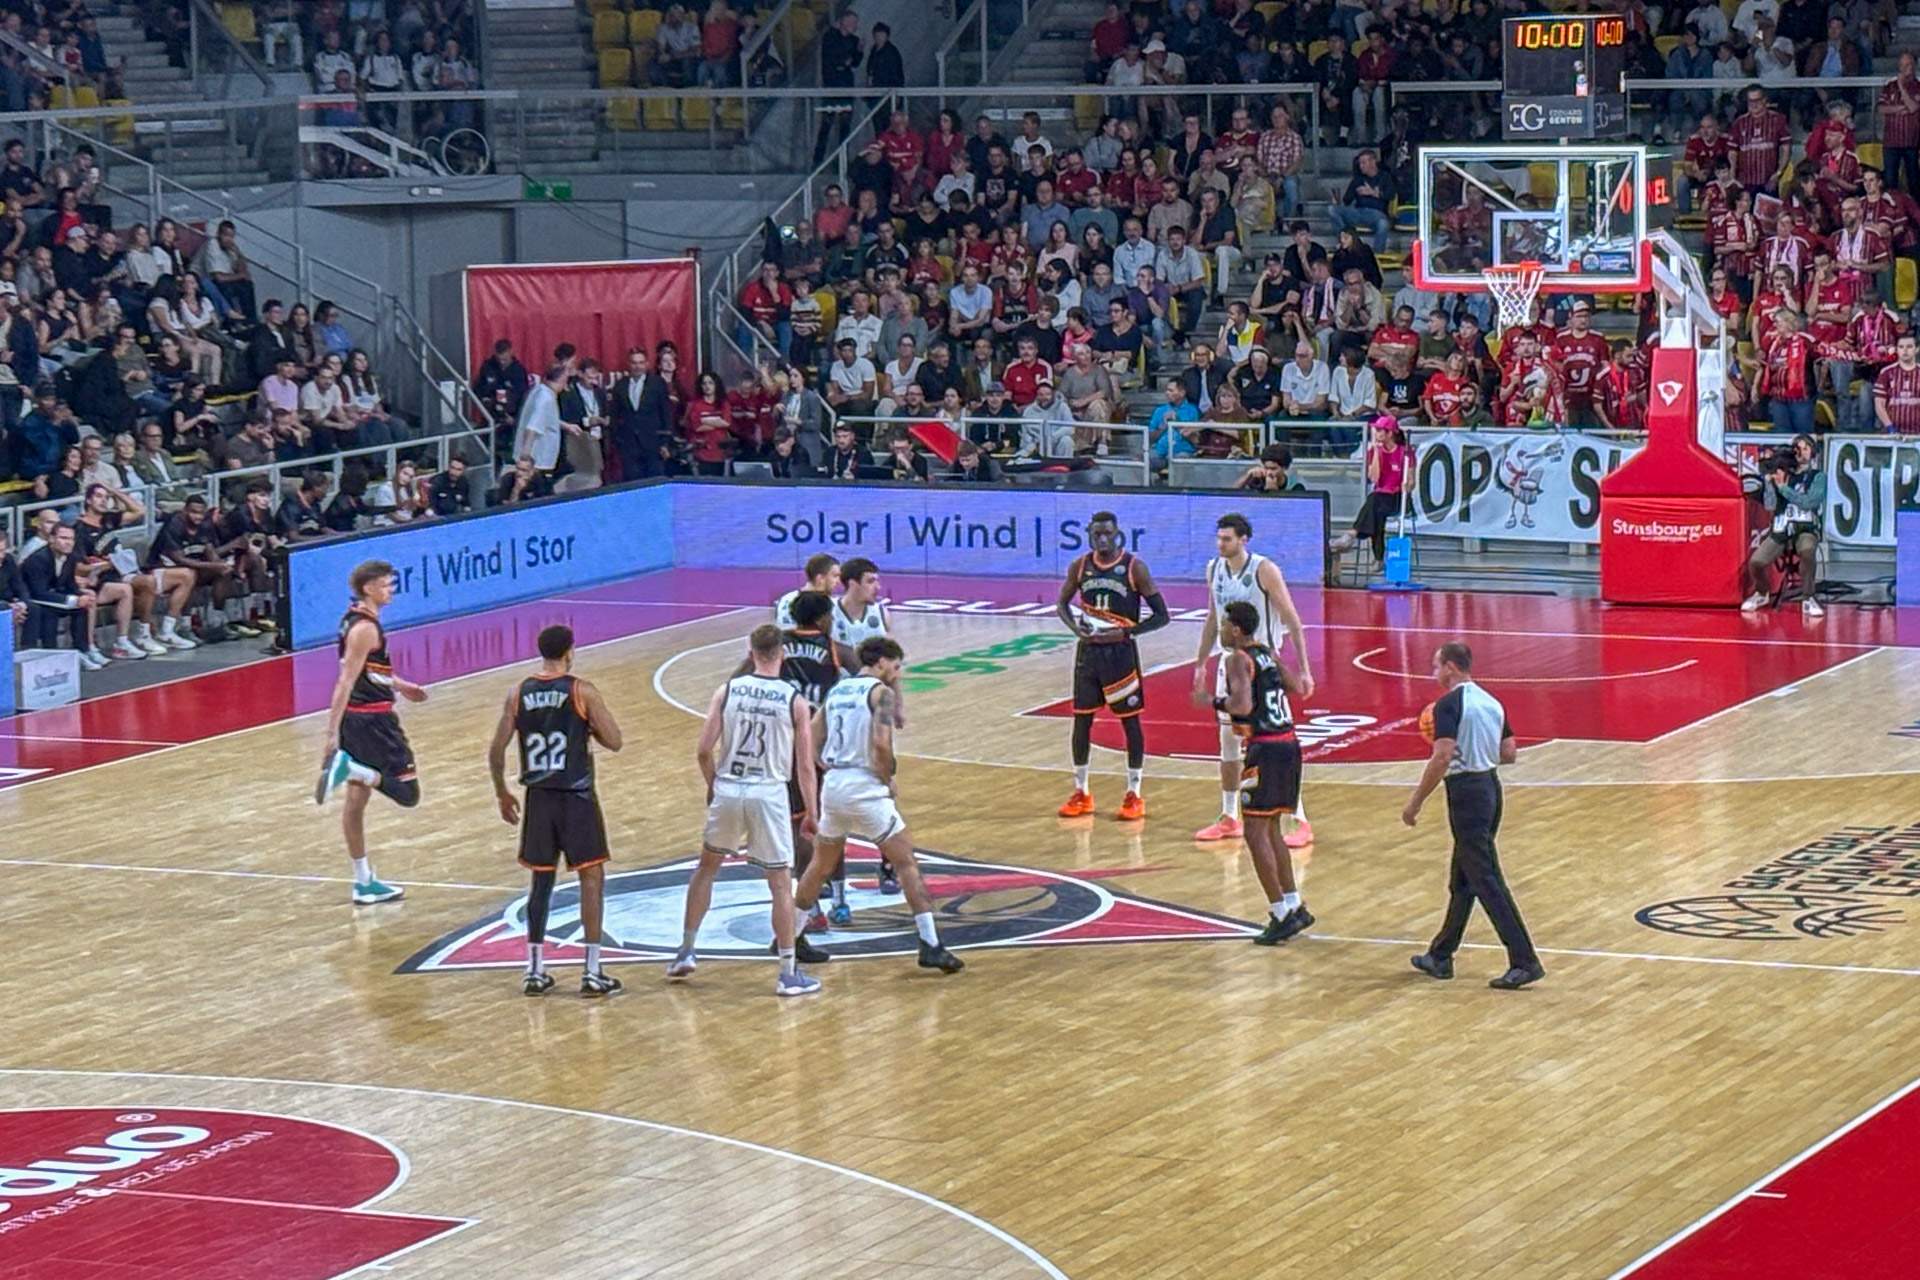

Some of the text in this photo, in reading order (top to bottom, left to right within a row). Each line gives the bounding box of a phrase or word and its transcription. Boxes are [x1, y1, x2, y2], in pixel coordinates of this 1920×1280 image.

[1516, 22, 1585, 49] 10:00
[1509, 103, 1546, 131] EG
[766, 512, 869, 545] Solar
[908, 514, 1018, 550] Wind
[436, 541, 502, 586] Wind
[526, 534, 576, 568] Stor
[526, 731, 568, 772] 22
[736, 719, 766, 759] 23
[832, 714, 845, 752] 3
[1722, 824, 1898, 890] BASKETBALL
